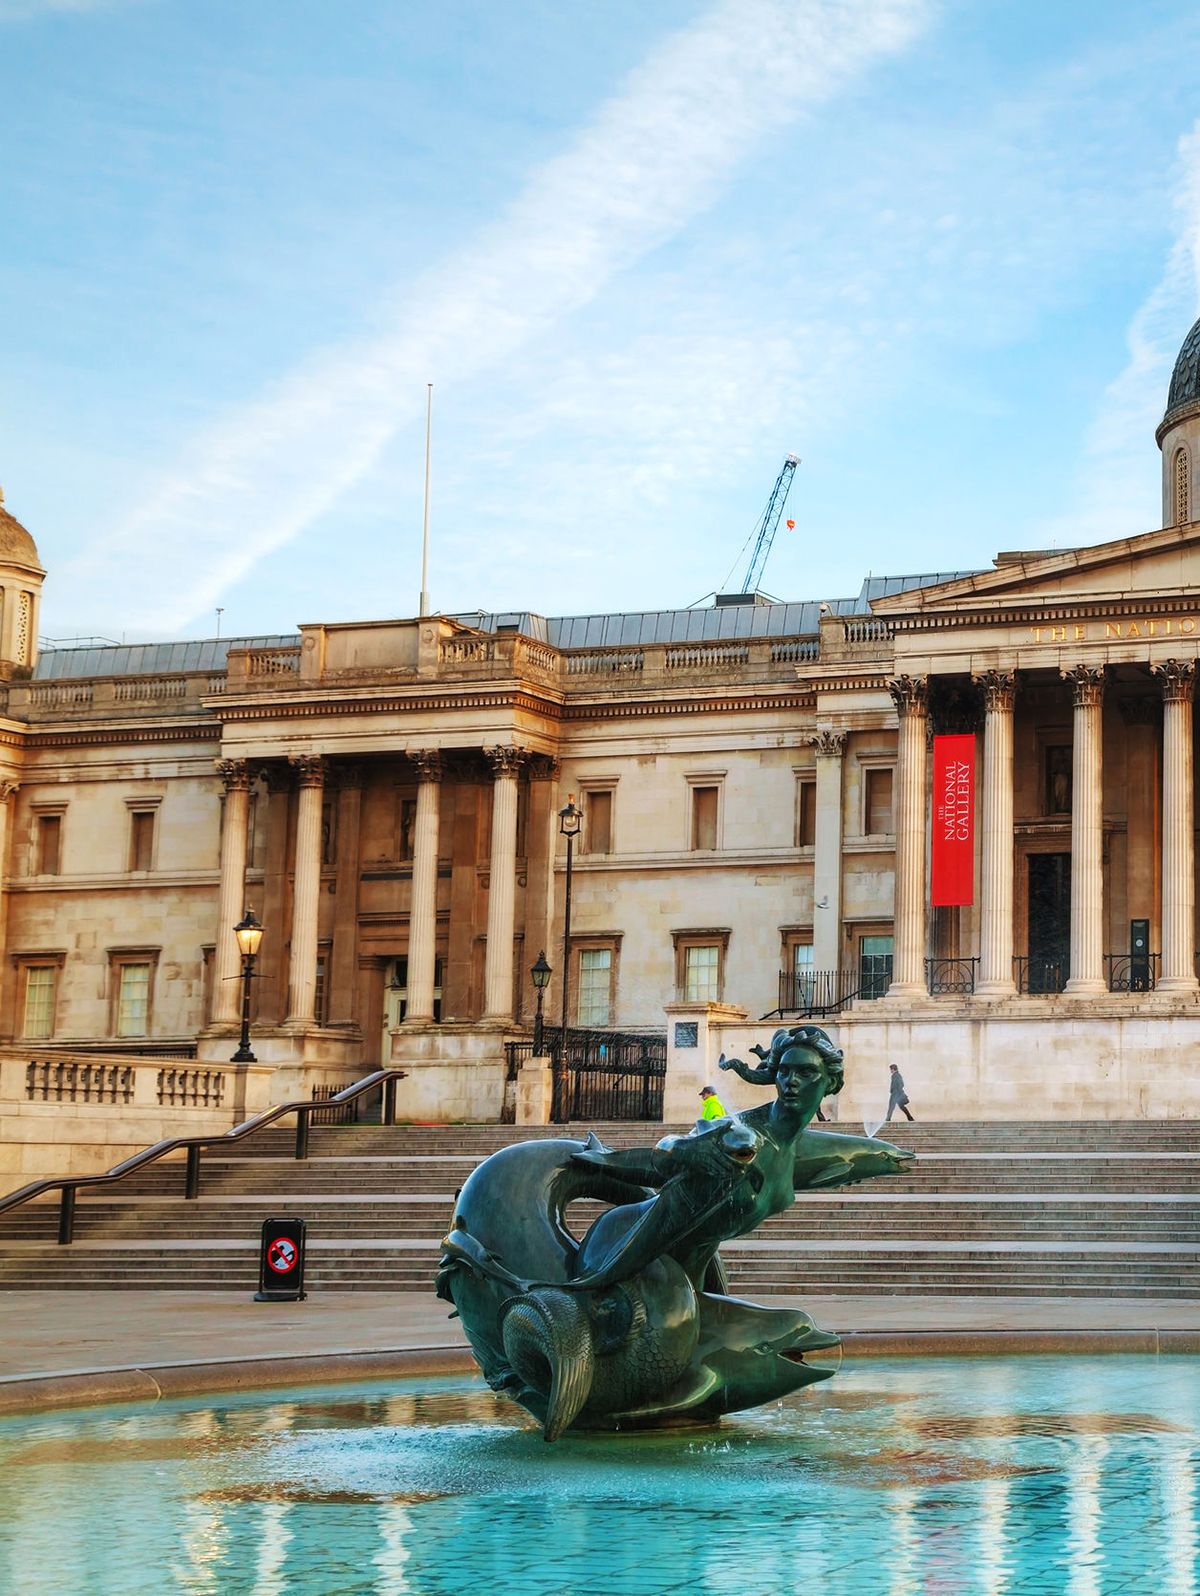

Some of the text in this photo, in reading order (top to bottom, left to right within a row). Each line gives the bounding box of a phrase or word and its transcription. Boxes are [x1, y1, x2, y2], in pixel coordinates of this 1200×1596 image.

[1031, 623, 1086, 643] THE
[945, 761, 956, 840] NATIONAL
[957, 761, 969, 840] GALLERY
